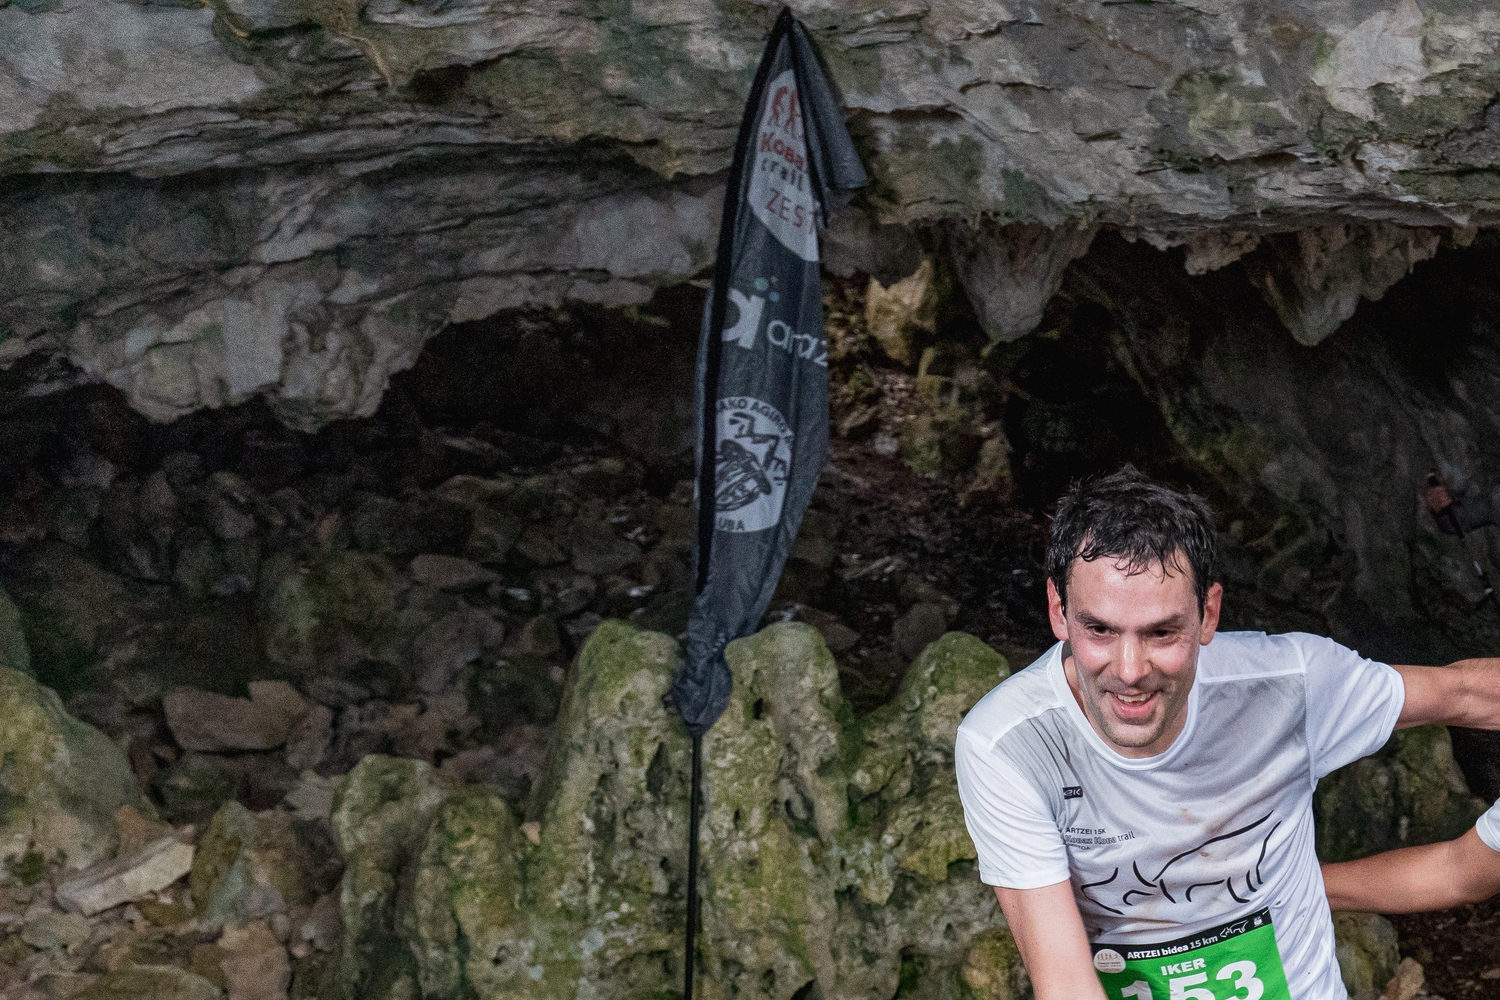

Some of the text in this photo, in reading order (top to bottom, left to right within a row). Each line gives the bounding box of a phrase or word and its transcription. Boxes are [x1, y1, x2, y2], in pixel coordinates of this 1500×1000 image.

[1066, 827, 1093, 835] ARTZEI
[1117, 831, 1136, 842] trail
[1127, 935, 1219, 960] ARTZEI bidea 15 km
[1160, 957, 1207, 976] IKER
